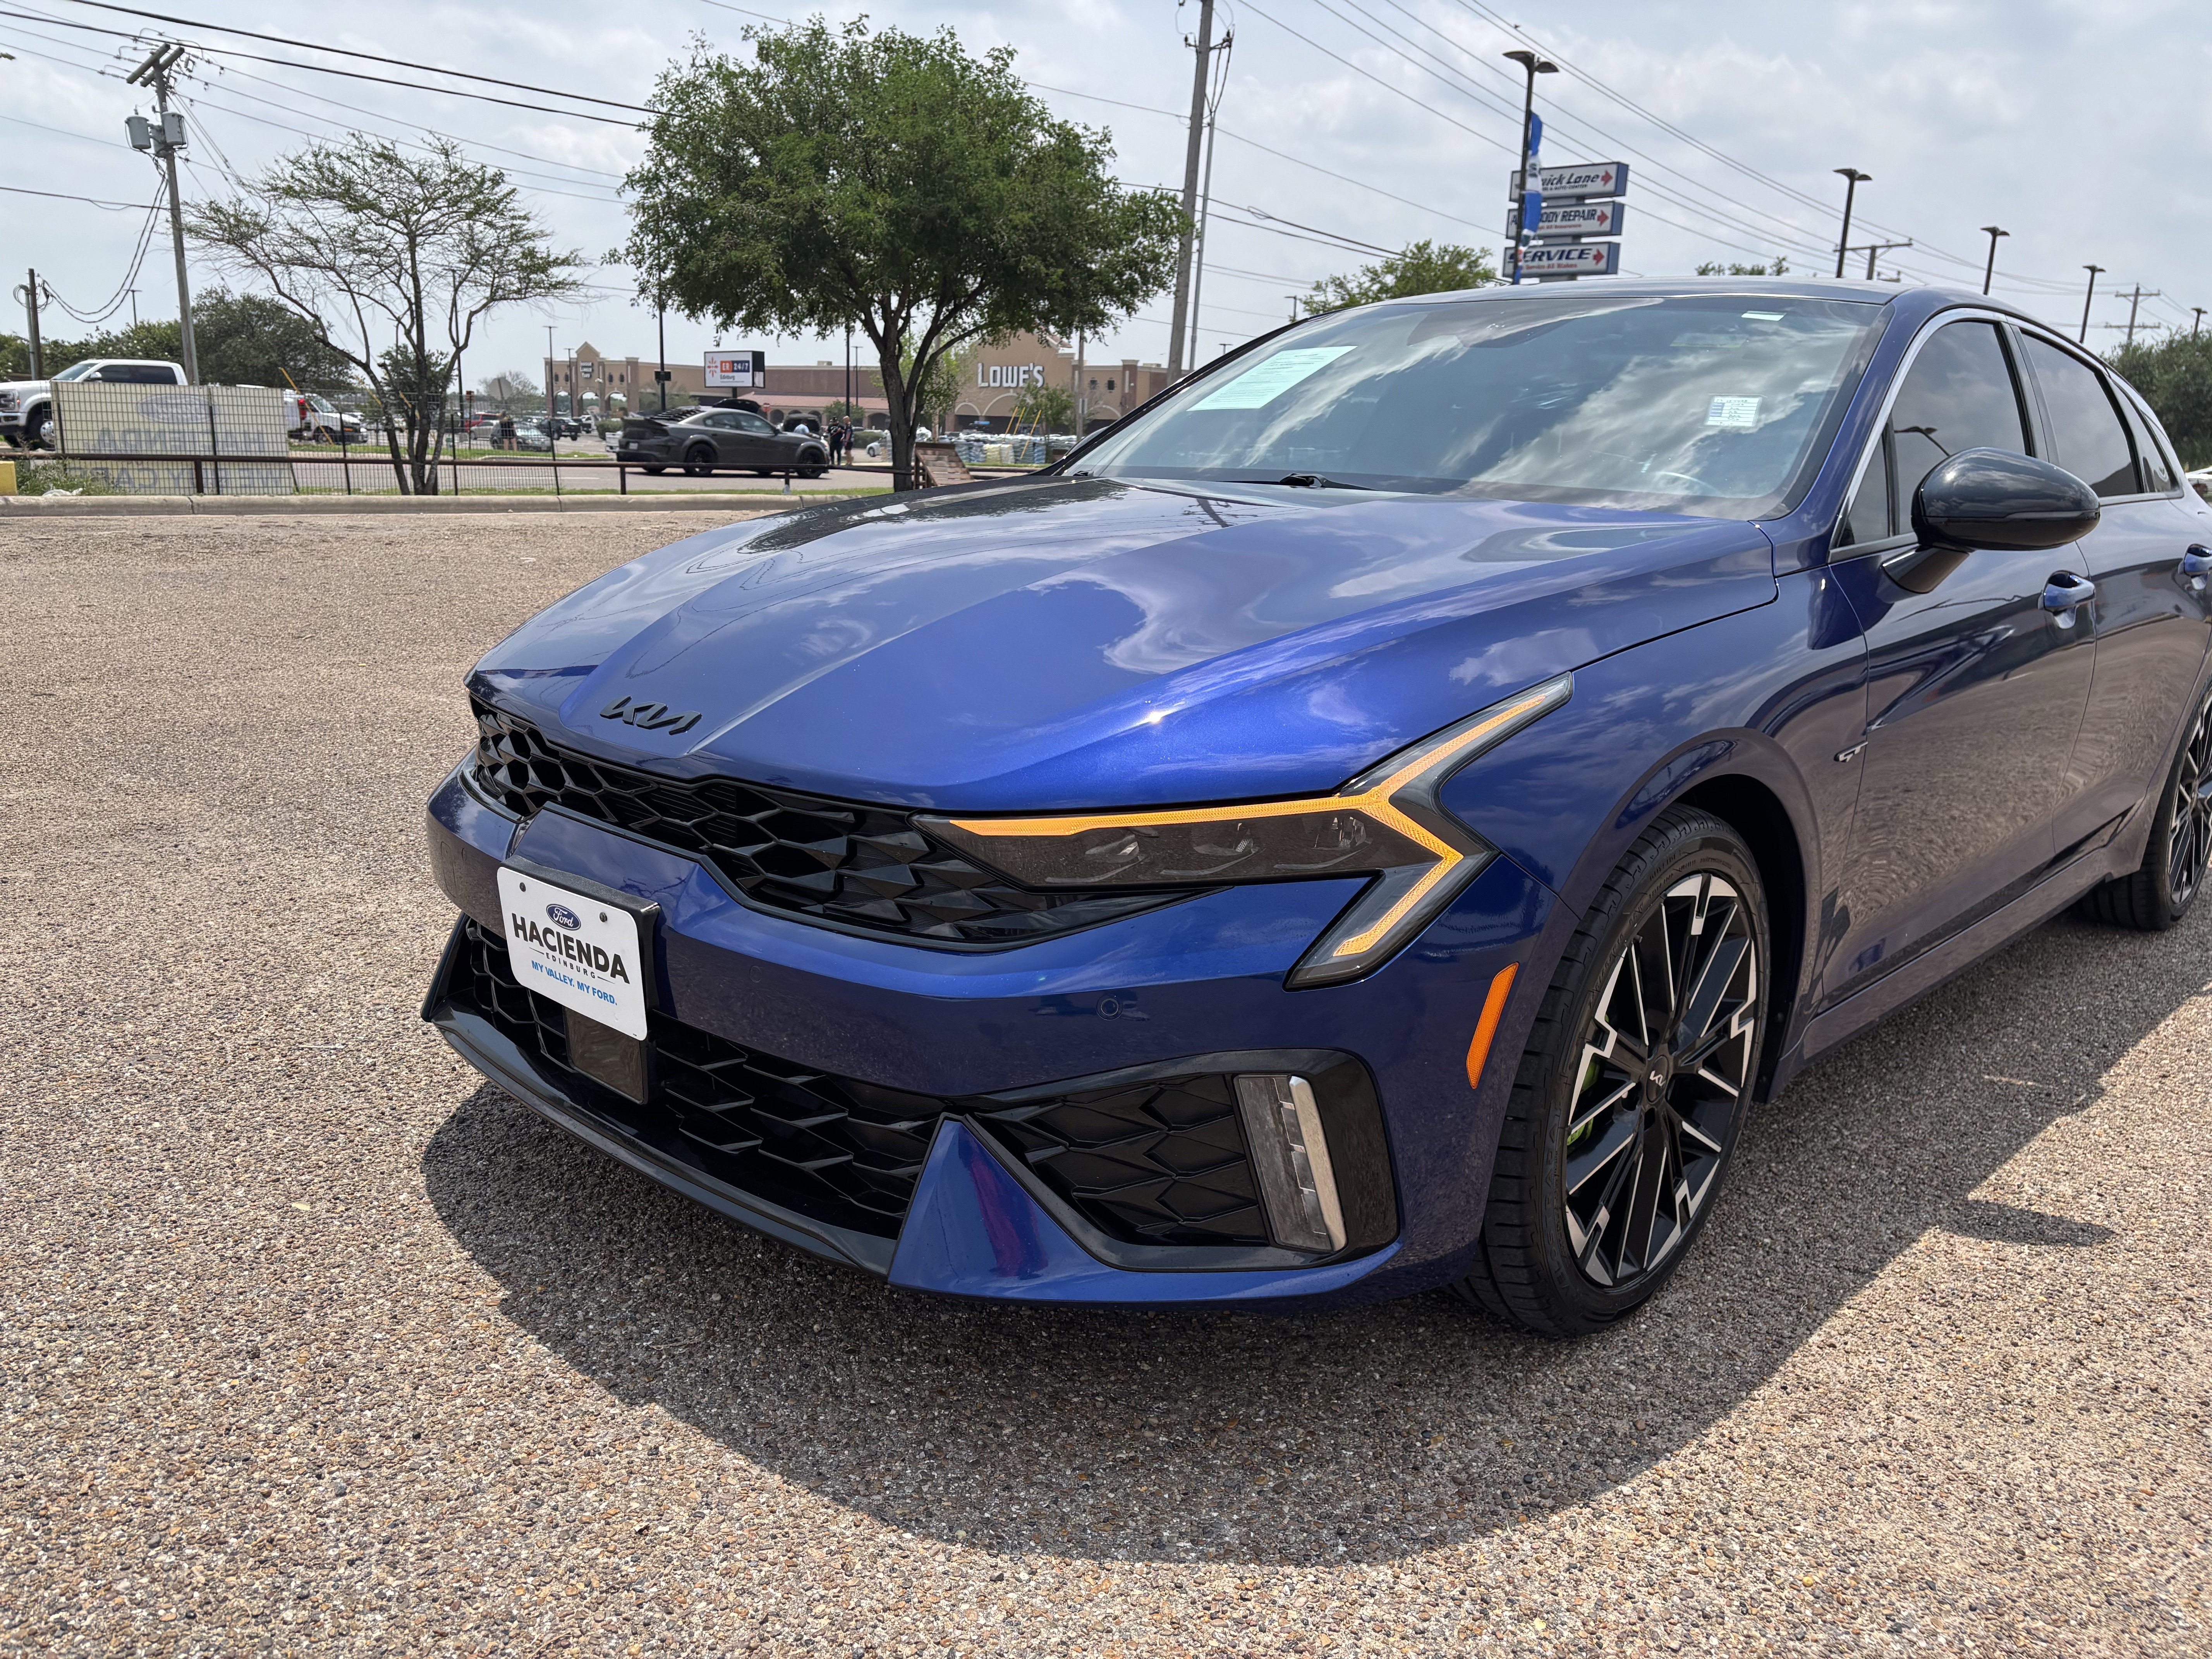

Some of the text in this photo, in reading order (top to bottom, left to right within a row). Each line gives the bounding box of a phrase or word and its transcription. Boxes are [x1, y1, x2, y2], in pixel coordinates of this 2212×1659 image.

[1566, 173, 1600, 184] Lane
[1561, 209, 1597, 221] REPAIR
[978, 362, 1044, 388] LOWE'S
[553, 907, 574, 927] Ford
[512, 913, 630, 984] HACIENDA
[546, 953, 596, 979] EDINBURG
[531, 960, 618, 1006] MY VALLEY. MY FORD.
